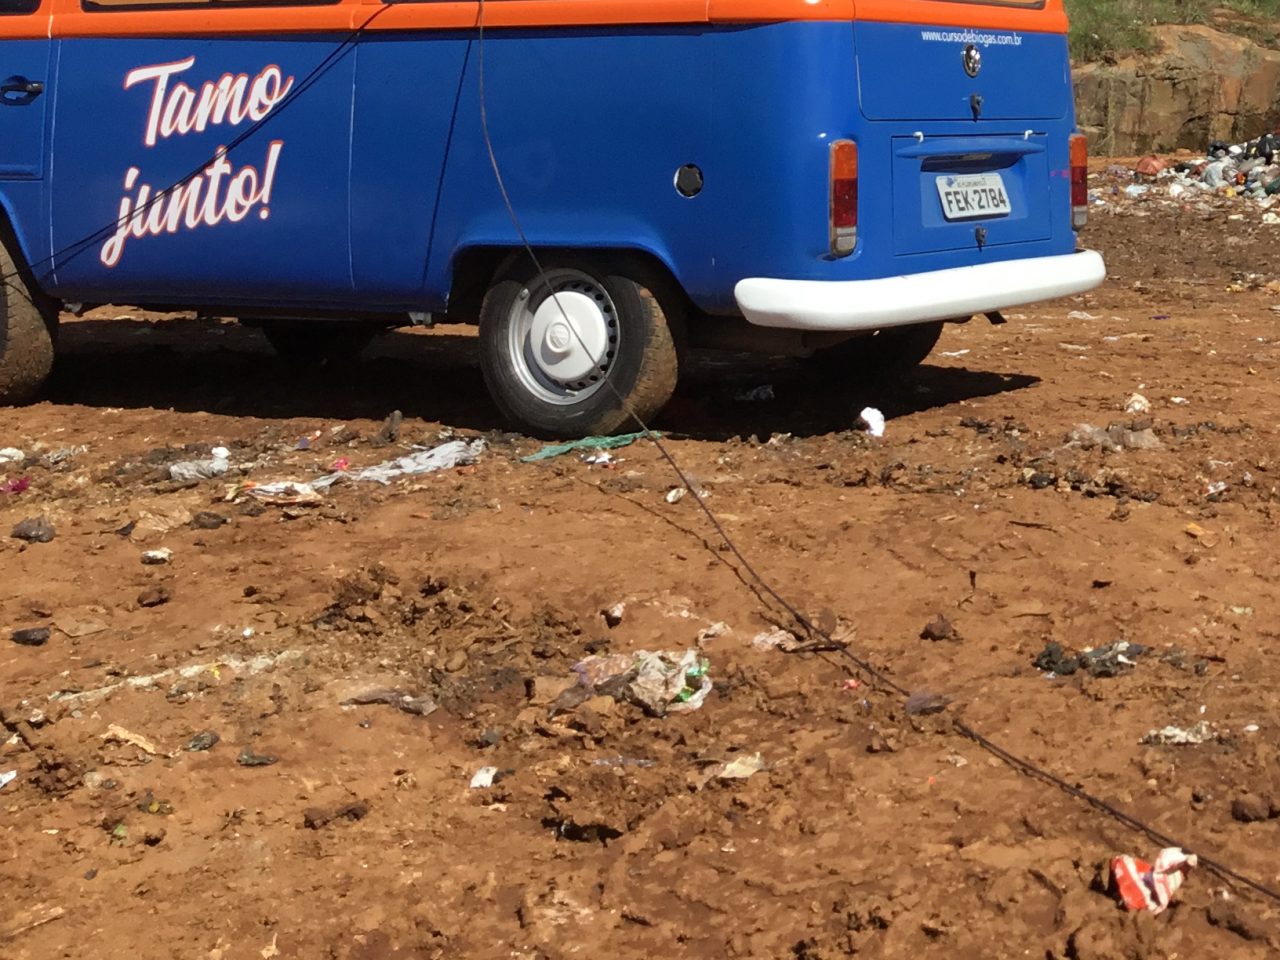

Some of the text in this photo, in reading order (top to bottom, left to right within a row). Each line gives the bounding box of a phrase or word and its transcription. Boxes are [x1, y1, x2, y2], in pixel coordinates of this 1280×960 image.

[921, 28, 1023, 47] www.cursodebiogas.com.br
[124, 55, 295, 146] Tamo
[100, 140, 285, 267] junto!
